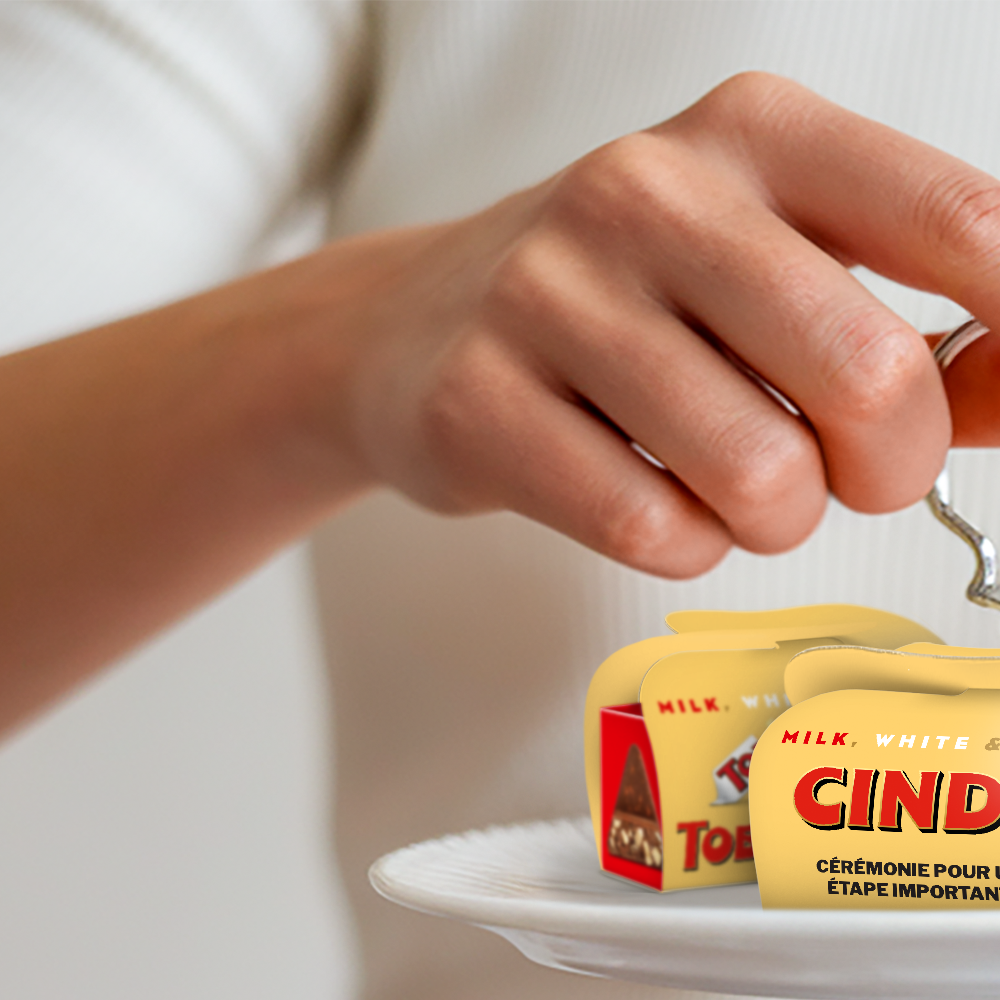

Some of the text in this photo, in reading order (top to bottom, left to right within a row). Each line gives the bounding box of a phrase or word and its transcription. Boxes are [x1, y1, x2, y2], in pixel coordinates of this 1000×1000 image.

[741, 693, 792, 708] WHI
[781, 730, 857, 748] MILK,
[875, 733, 969, 751] WHITE
[984, 737, 1000, 751] &
[816, 856, 930, 878] CÉRÉMONIE
[933, 863, 990, 880] POUR
[827, 877, 889, 897] ÉTAPE
